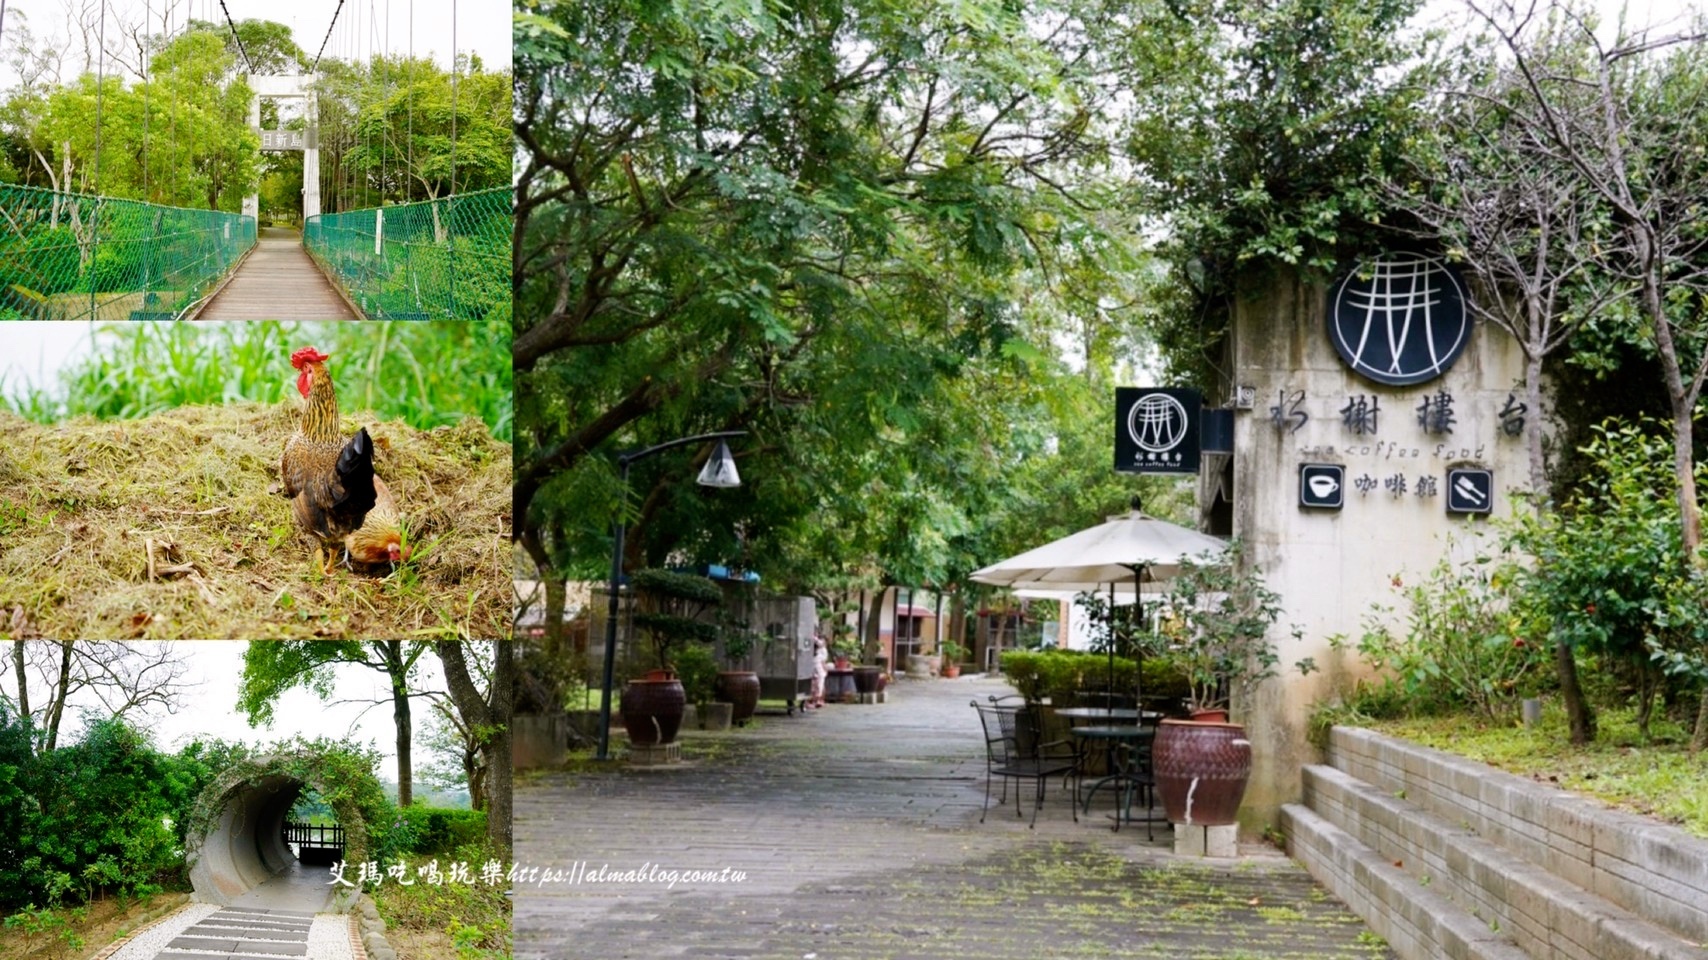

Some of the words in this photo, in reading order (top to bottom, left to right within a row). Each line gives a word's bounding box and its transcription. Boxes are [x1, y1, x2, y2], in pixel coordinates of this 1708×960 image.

[263, 133, 302, 147] 日新島
[1344, 441, 1420, 460] coffee
[1432, 443, 1485, 460] food
[1354, 473, 1437, 498] 咖啡館
